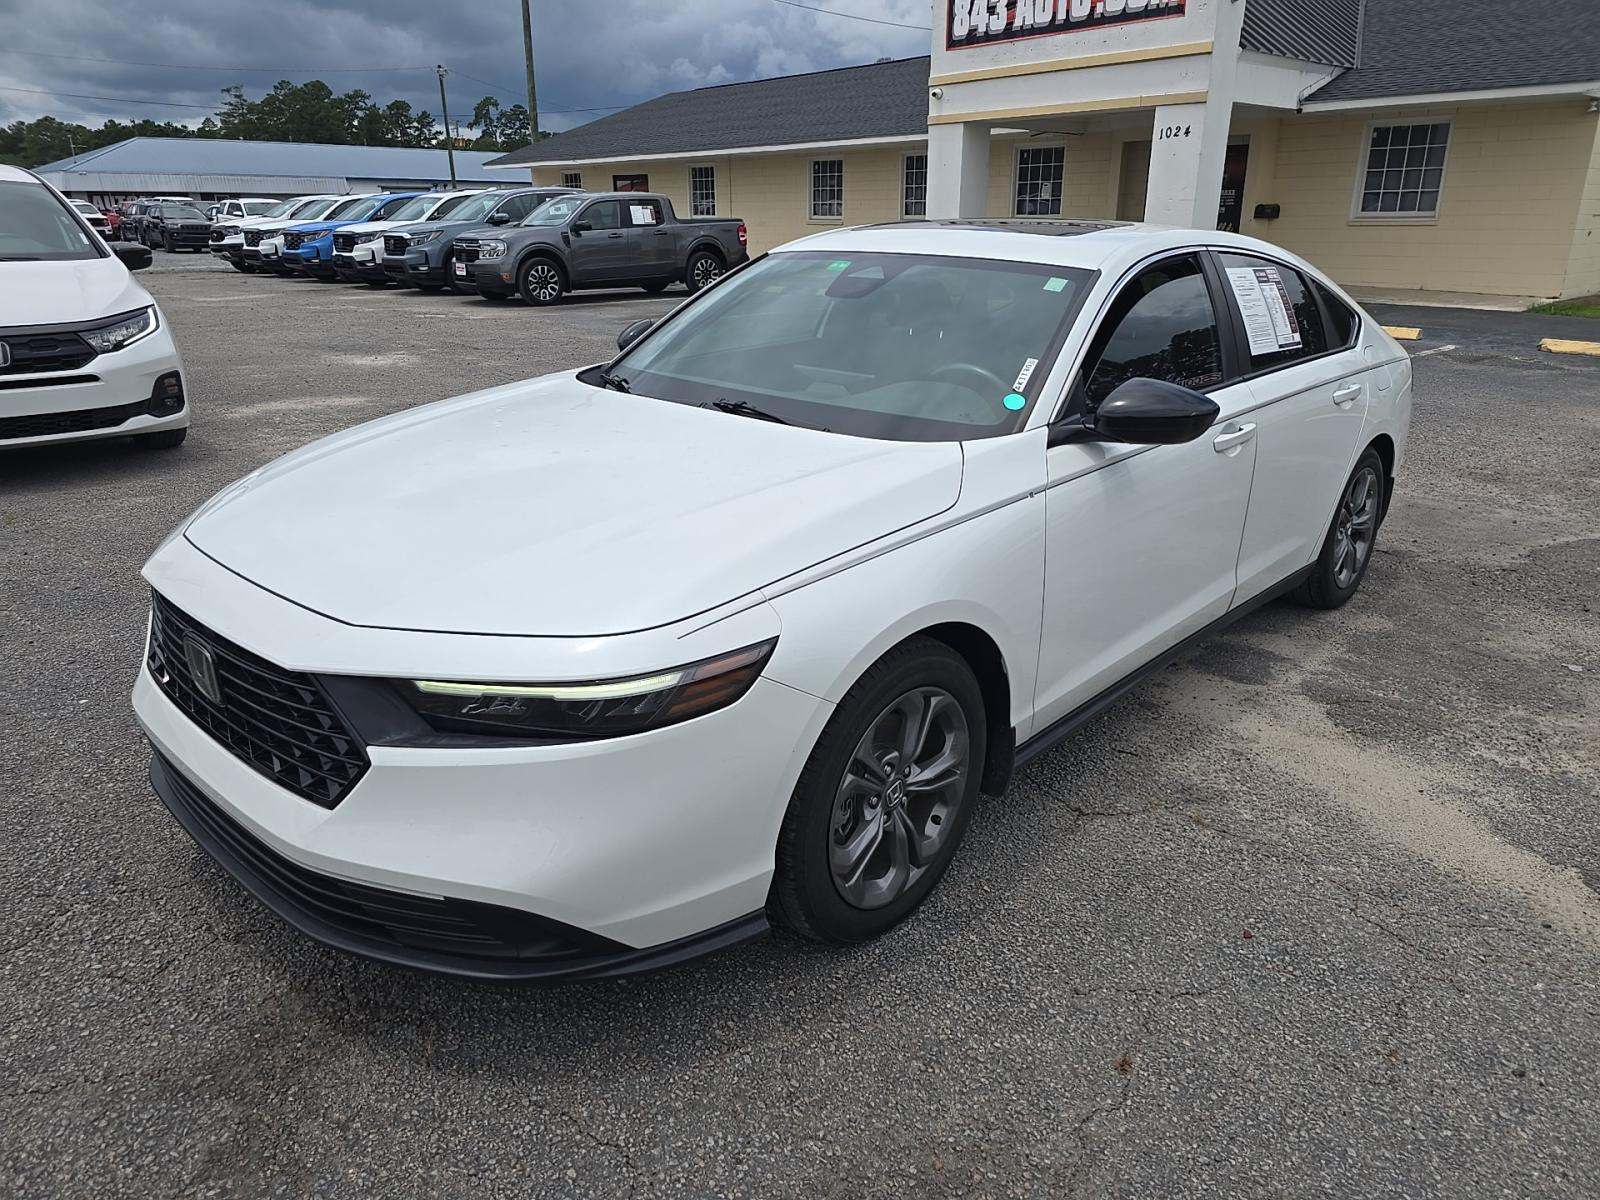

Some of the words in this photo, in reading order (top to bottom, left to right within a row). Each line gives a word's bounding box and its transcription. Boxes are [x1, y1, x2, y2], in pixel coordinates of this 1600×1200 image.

[952, 0, 1008, 38] 843
[1012, 0, 1178, 28] AUTO.
[1160, 125, 1191, 140] 1024
